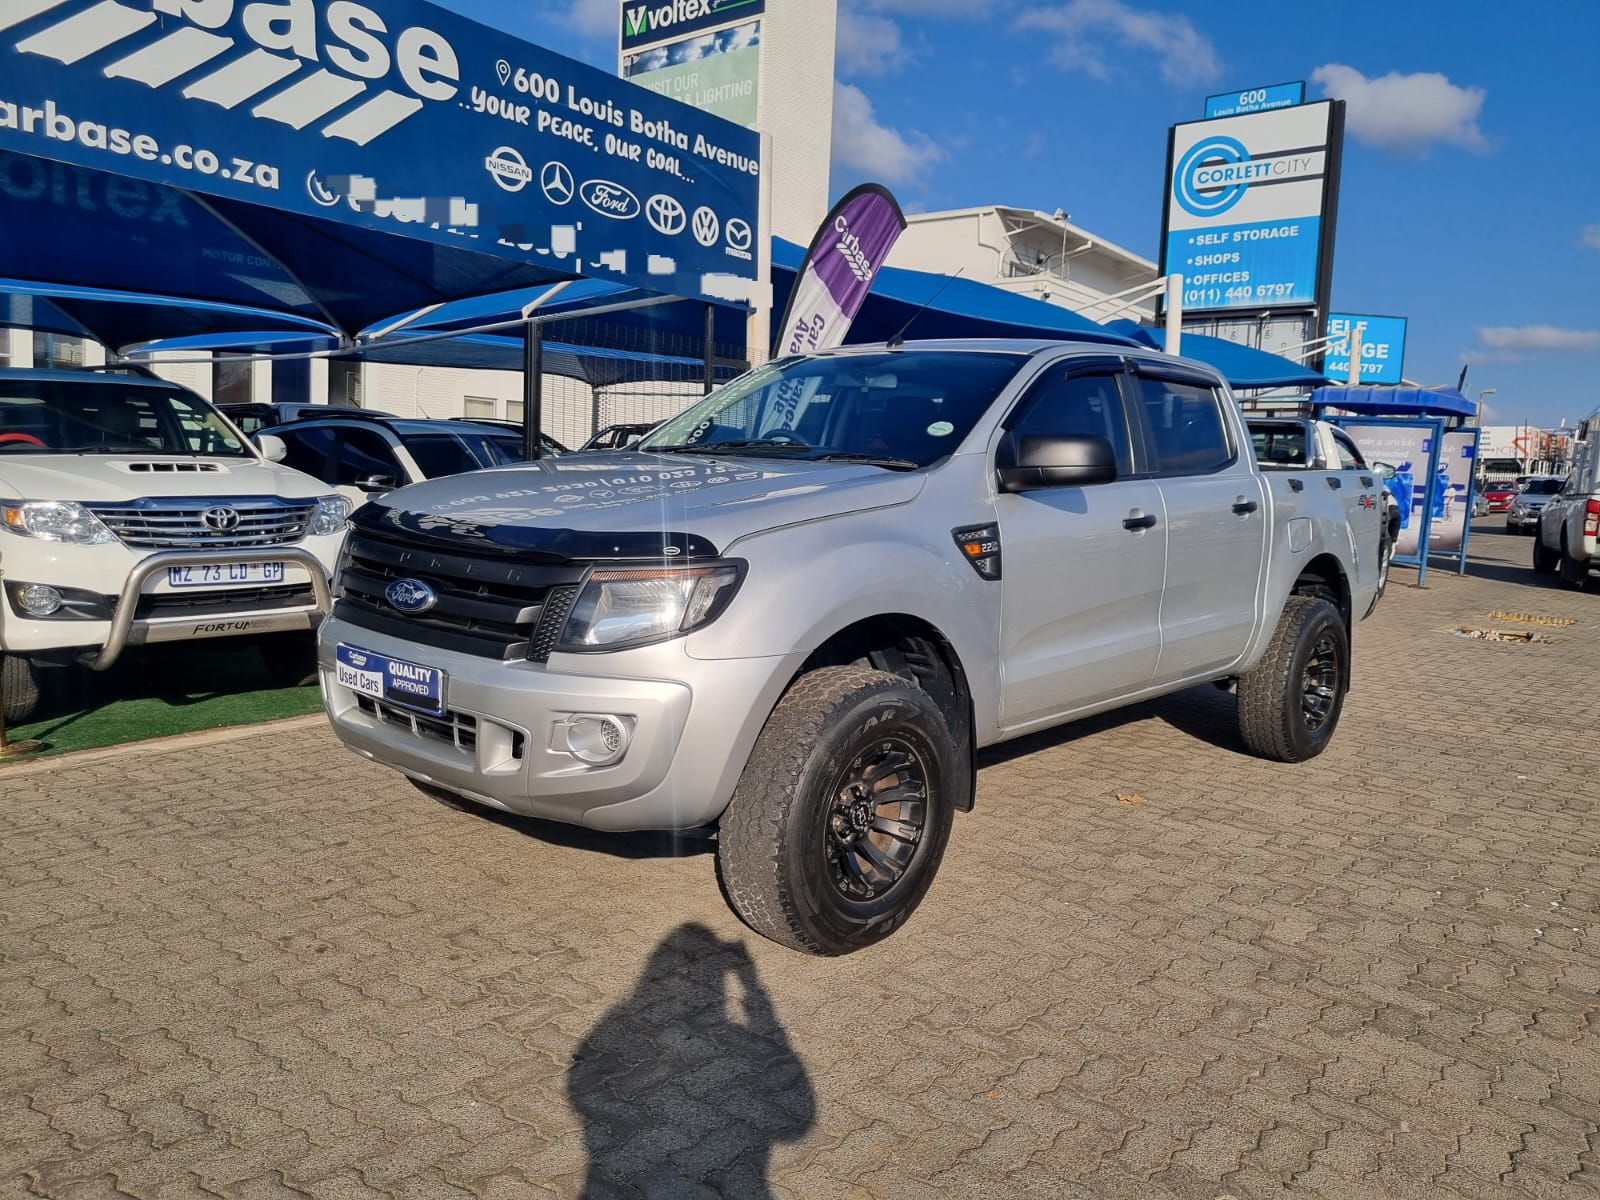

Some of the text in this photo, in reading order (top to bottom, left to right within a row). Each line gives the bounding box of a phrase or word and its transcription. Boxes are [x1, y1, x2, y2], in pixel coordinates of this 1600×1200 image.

[674, 72, 699, 92] OUR
[695, 79, 752, 105] LIGHTING
[1239, 88, 1267, 106] 600
[1213, 98, 1292, 118] Louis Botha Avenue
[514, 67, 759, 176] 600 Louis Botha Avenue
[0, 100, 280, 190] arbase.co.za
[537, 109, 599, 152] PEACE,
[605, 133, 641, 163] OUR
[487, 159, 531, 179] NISSAN
[591, 184, 630, 213] Ford
[1196, 225, 1299, 246] SELF STORAGE
[1194, 252, 1240, 266] SHOPS
[1193, 271, 1250, 286] OFFICES
[1185, 283, 1295, 304] (011) 440 6797
[789, 317, 810, 354] Ava
[807, 313, 825, 350] Car
[172, 562, 280, 582] MZ 73 LD GP
[339, 666, 379, 693] Used Cars
[388, 661, 432, 683] QUALITY
[392, 677, 429, 696] APPROVED
